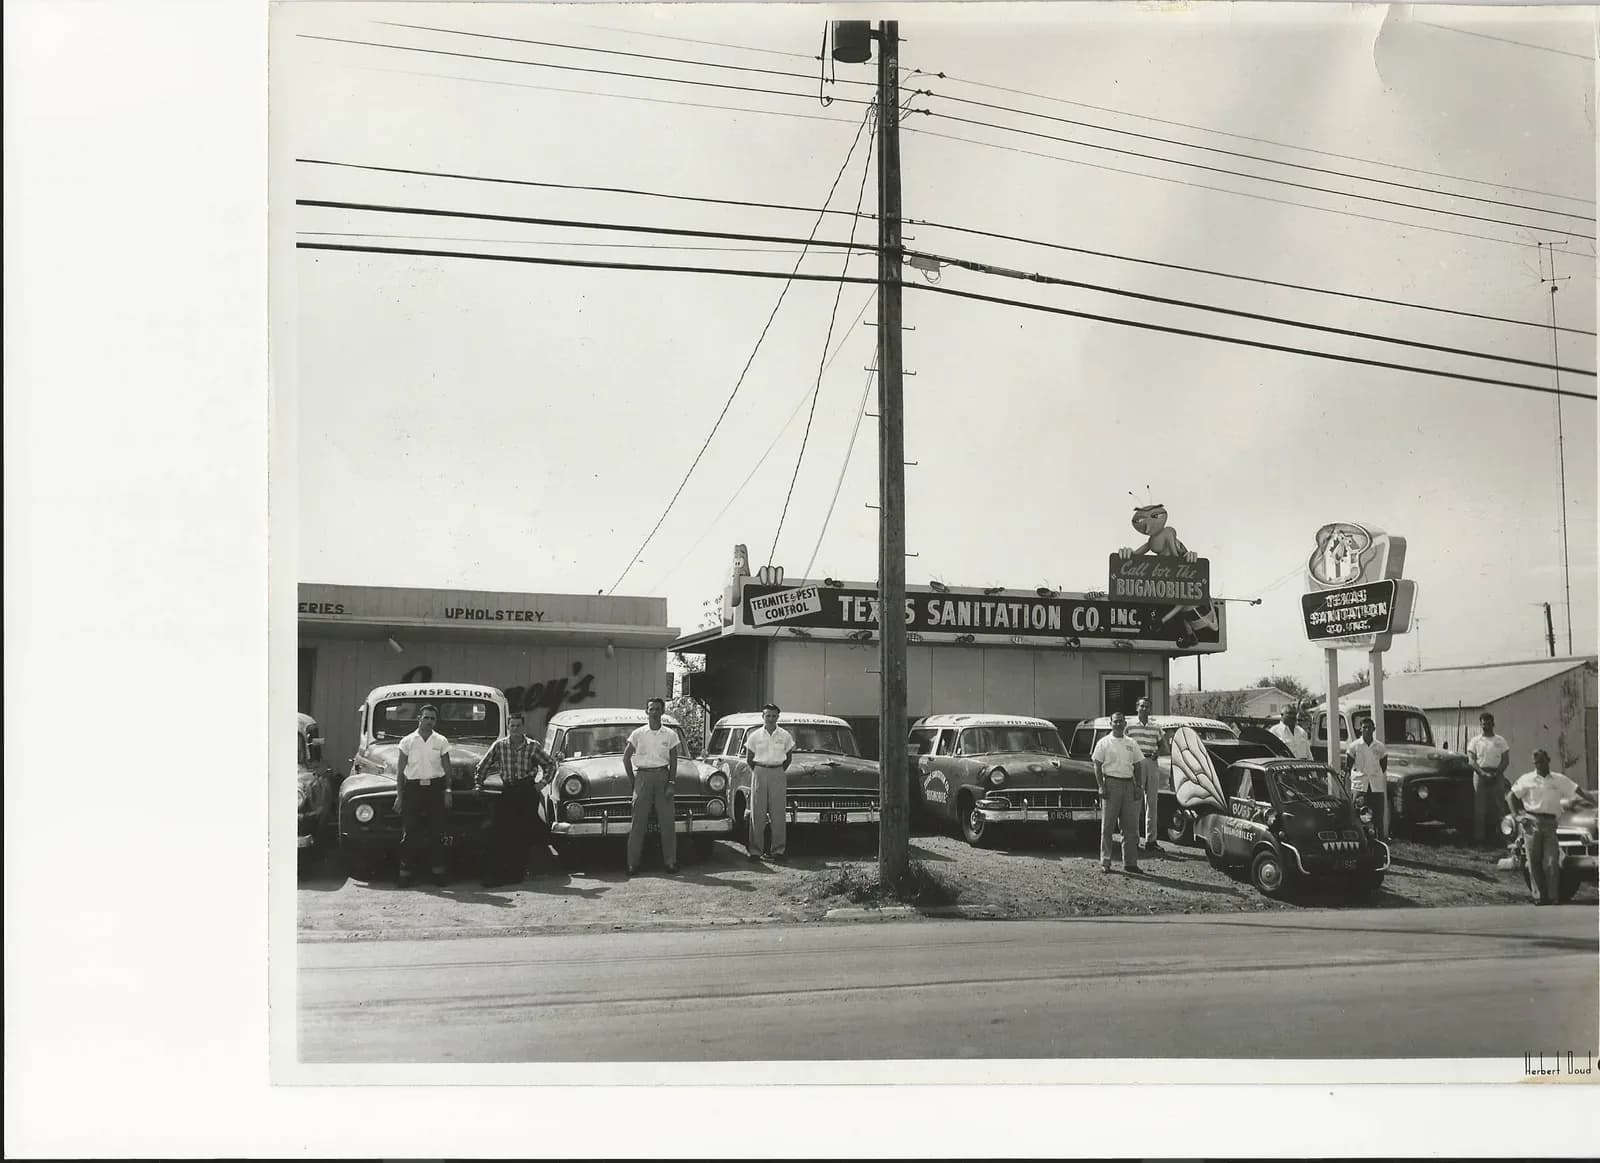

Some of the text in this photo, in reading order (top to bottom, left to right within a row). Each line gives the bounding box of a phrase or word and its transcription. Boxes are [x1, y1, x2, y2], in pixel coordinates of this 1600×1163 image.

[1120, 560, 1149, 577] Call
[752, 593, 789, 611] TERMITE
[796, 587, 817, 601] PEST
[1326, 589, 1368, 608] TEXAS
[445, 606, 545, 623] UPHOLSTERY
[765, 602, 809, 620] CONTROL
[838, 595, 1142, 633] TEXS SANITATION CO. INC.
[1309, 602, 1388, 626] SANITATION
[413, 688, 493, 699] INSPECTION
